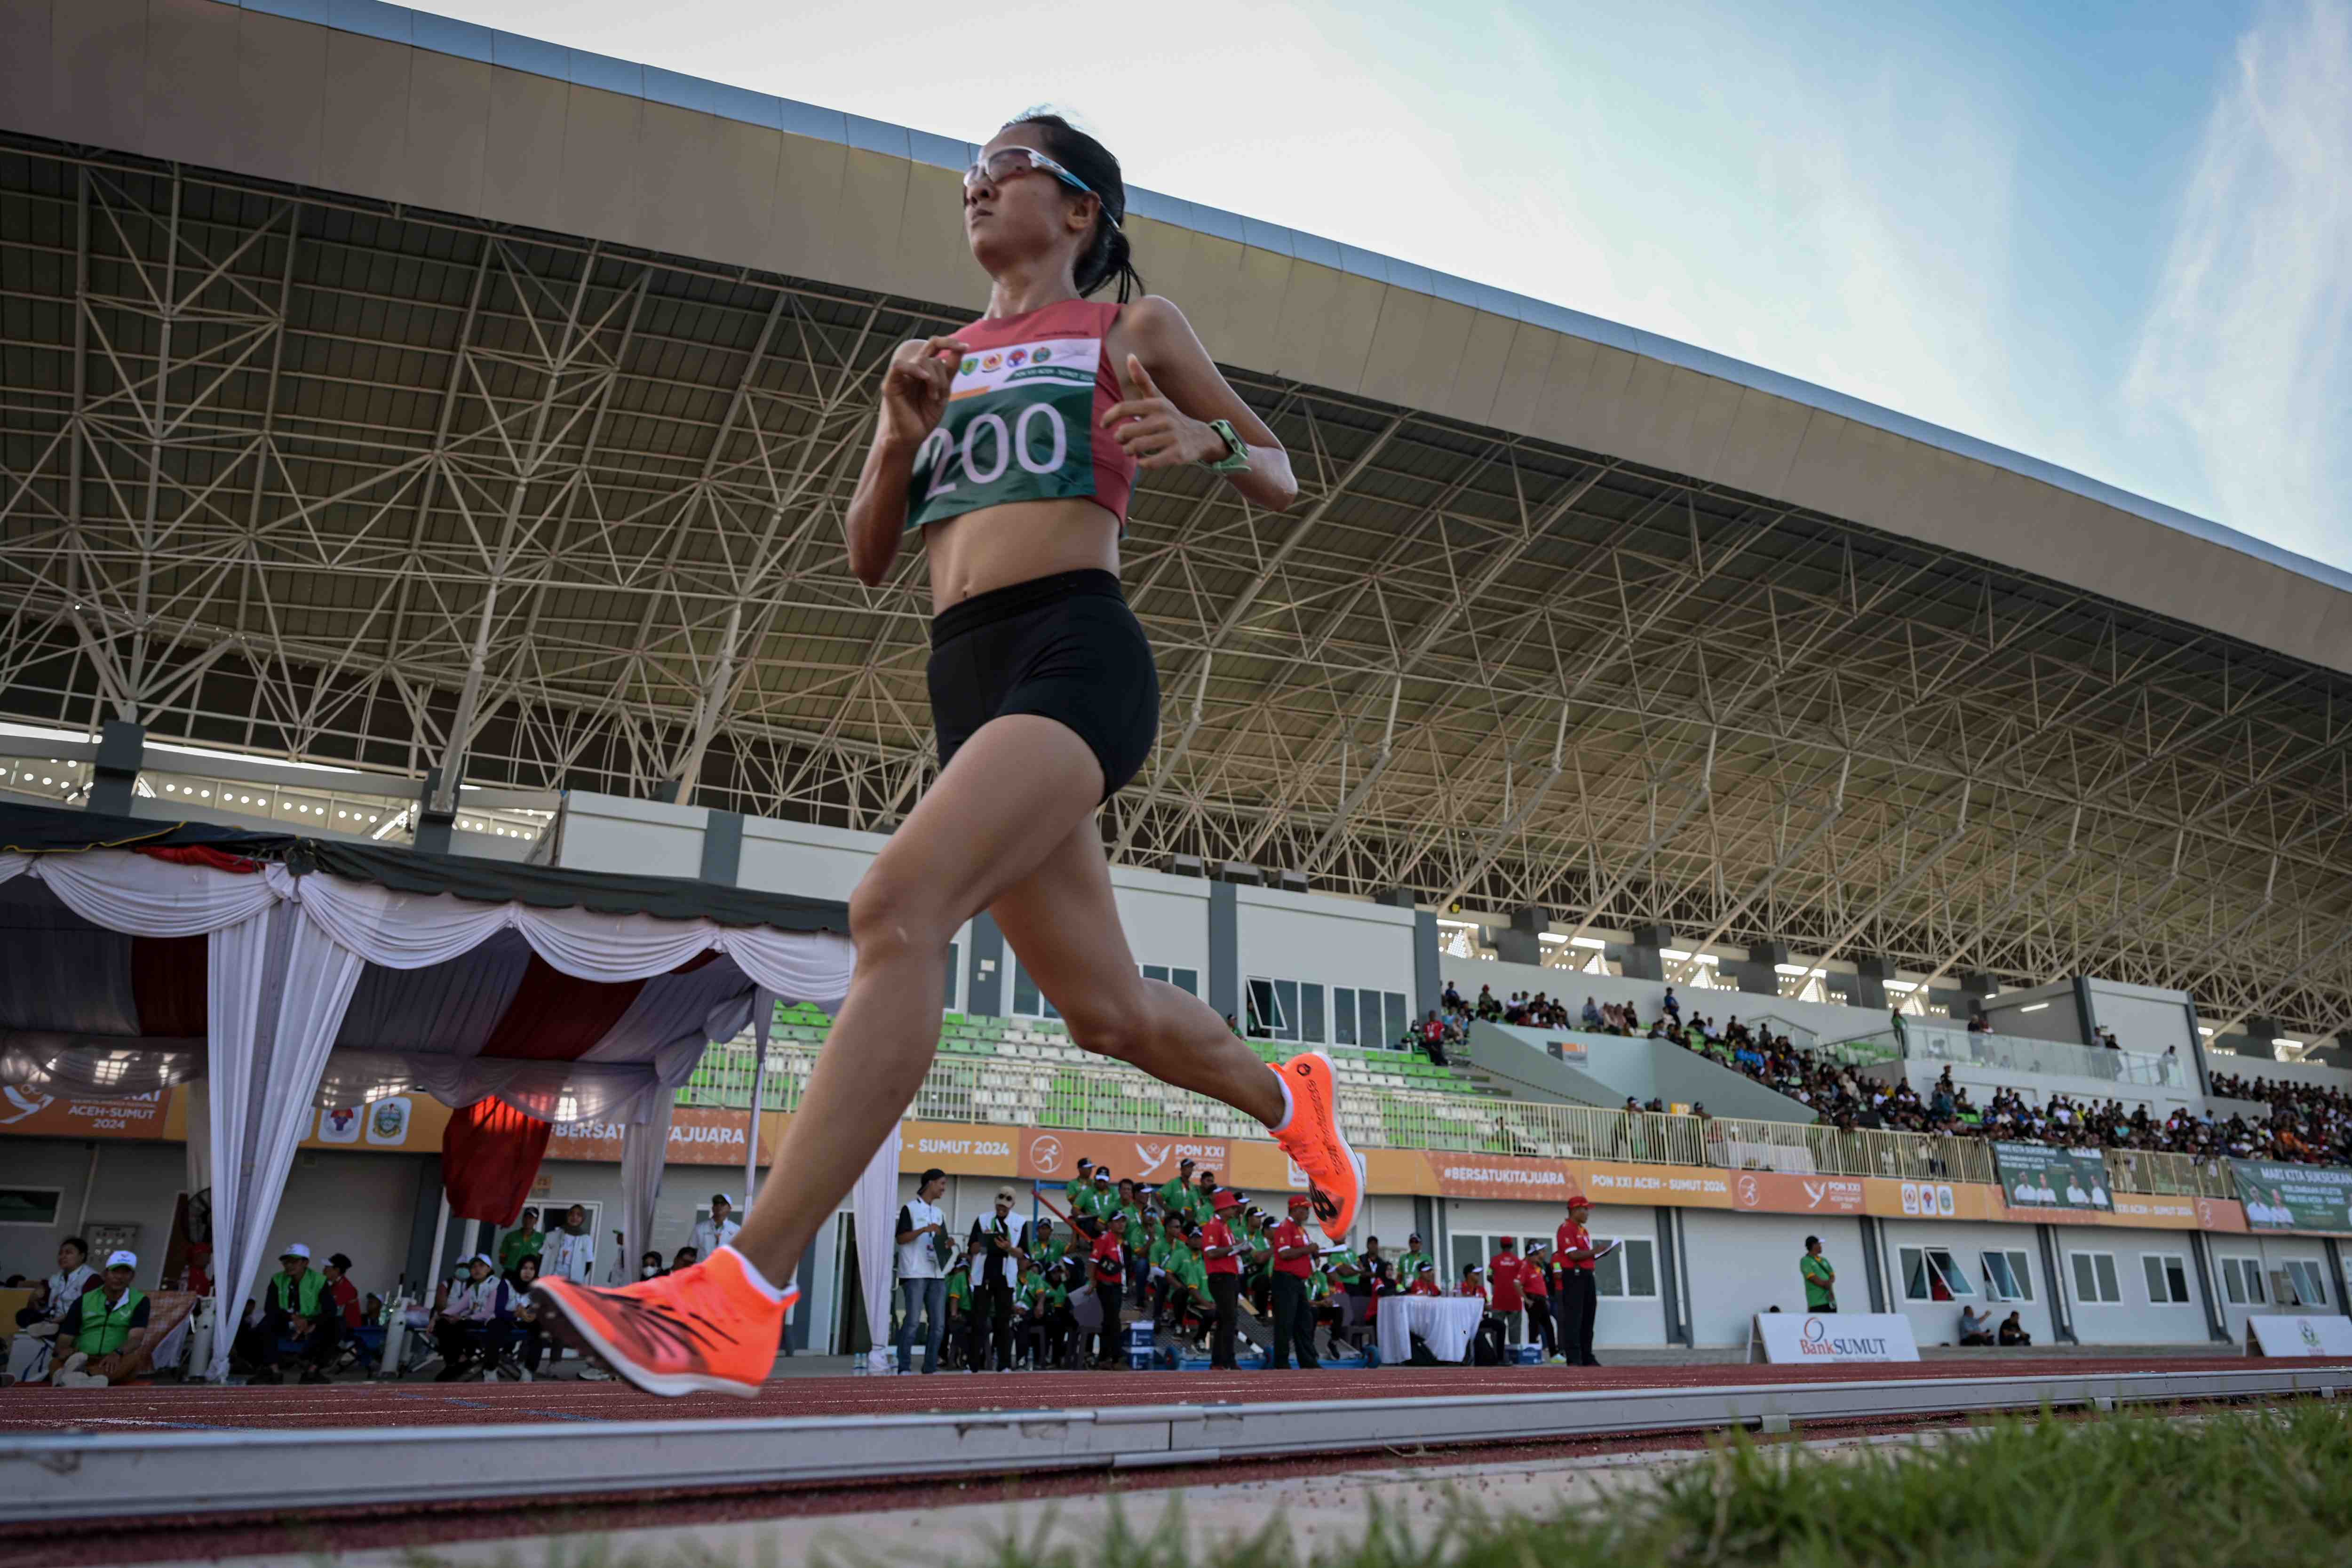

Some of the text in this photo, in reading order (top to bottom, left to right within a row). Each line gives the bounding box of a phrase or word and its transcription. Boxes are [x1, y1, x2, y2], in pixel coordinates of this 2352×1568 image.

[912, 402, 1067, 501] 200
[68, 1105, 155, 1119] ACEH-SUMUT
[92, 1118, 126, 1129] 2024
[919, 1138, 971, 1154] SUMUT
[974, 1141, 1010, 1155] 2024
[1175, 1144, 1225, 1158] PON XXI
[1444, 1167, 1566, 1185] #BERSATUKITAJUARA
[1592, 1174, 1613, 1186] PON
[1615, 1175, 1632, 1187] XXI
[1634, 1177, 1661, 1189] ACEH
[1669, 1179, 1701, 1191] SUMUT
[1703, 1180, 1727, 1193] 2024
